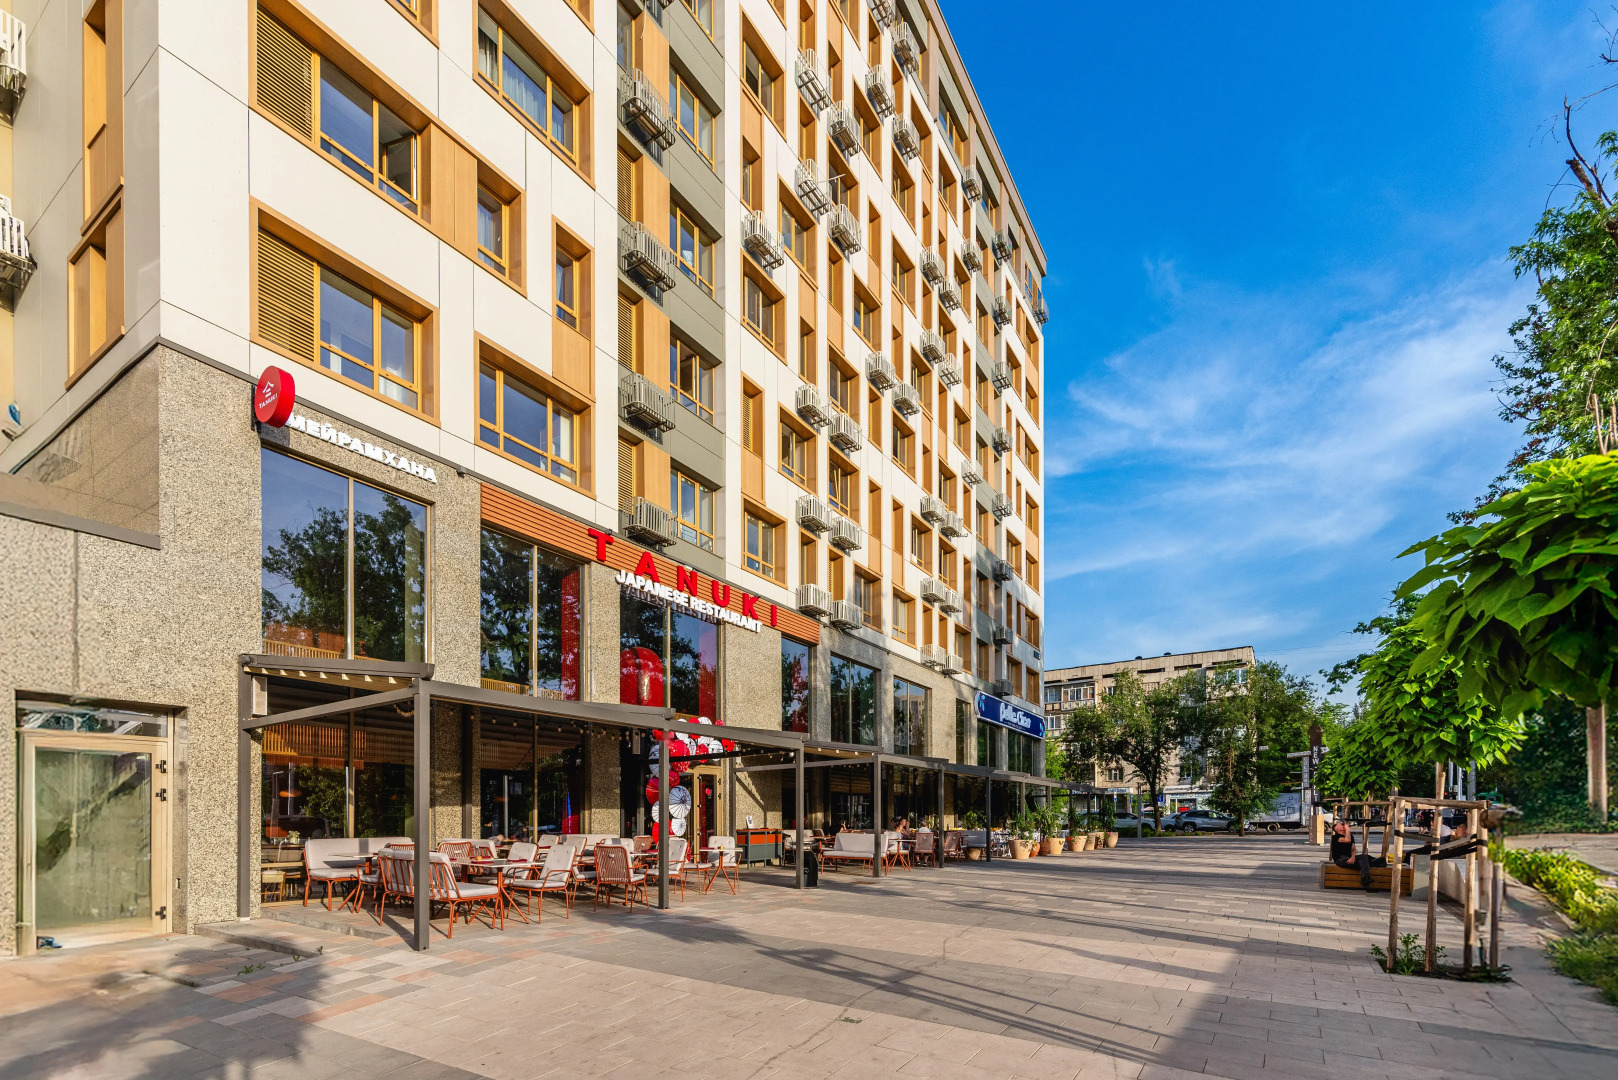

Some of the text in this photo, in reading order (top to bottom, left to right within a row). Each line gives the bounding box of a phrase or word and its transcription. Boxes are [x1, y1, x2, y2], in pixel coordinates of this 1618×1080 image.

[259, 393, 278, 409] TANUKI
[285, 412, 437, 484] МЕЙРАМХАНА
[588, 528, 778, 627] TANUKI
[616, 570, 763, 633] JAPANESE RESTAURANT
